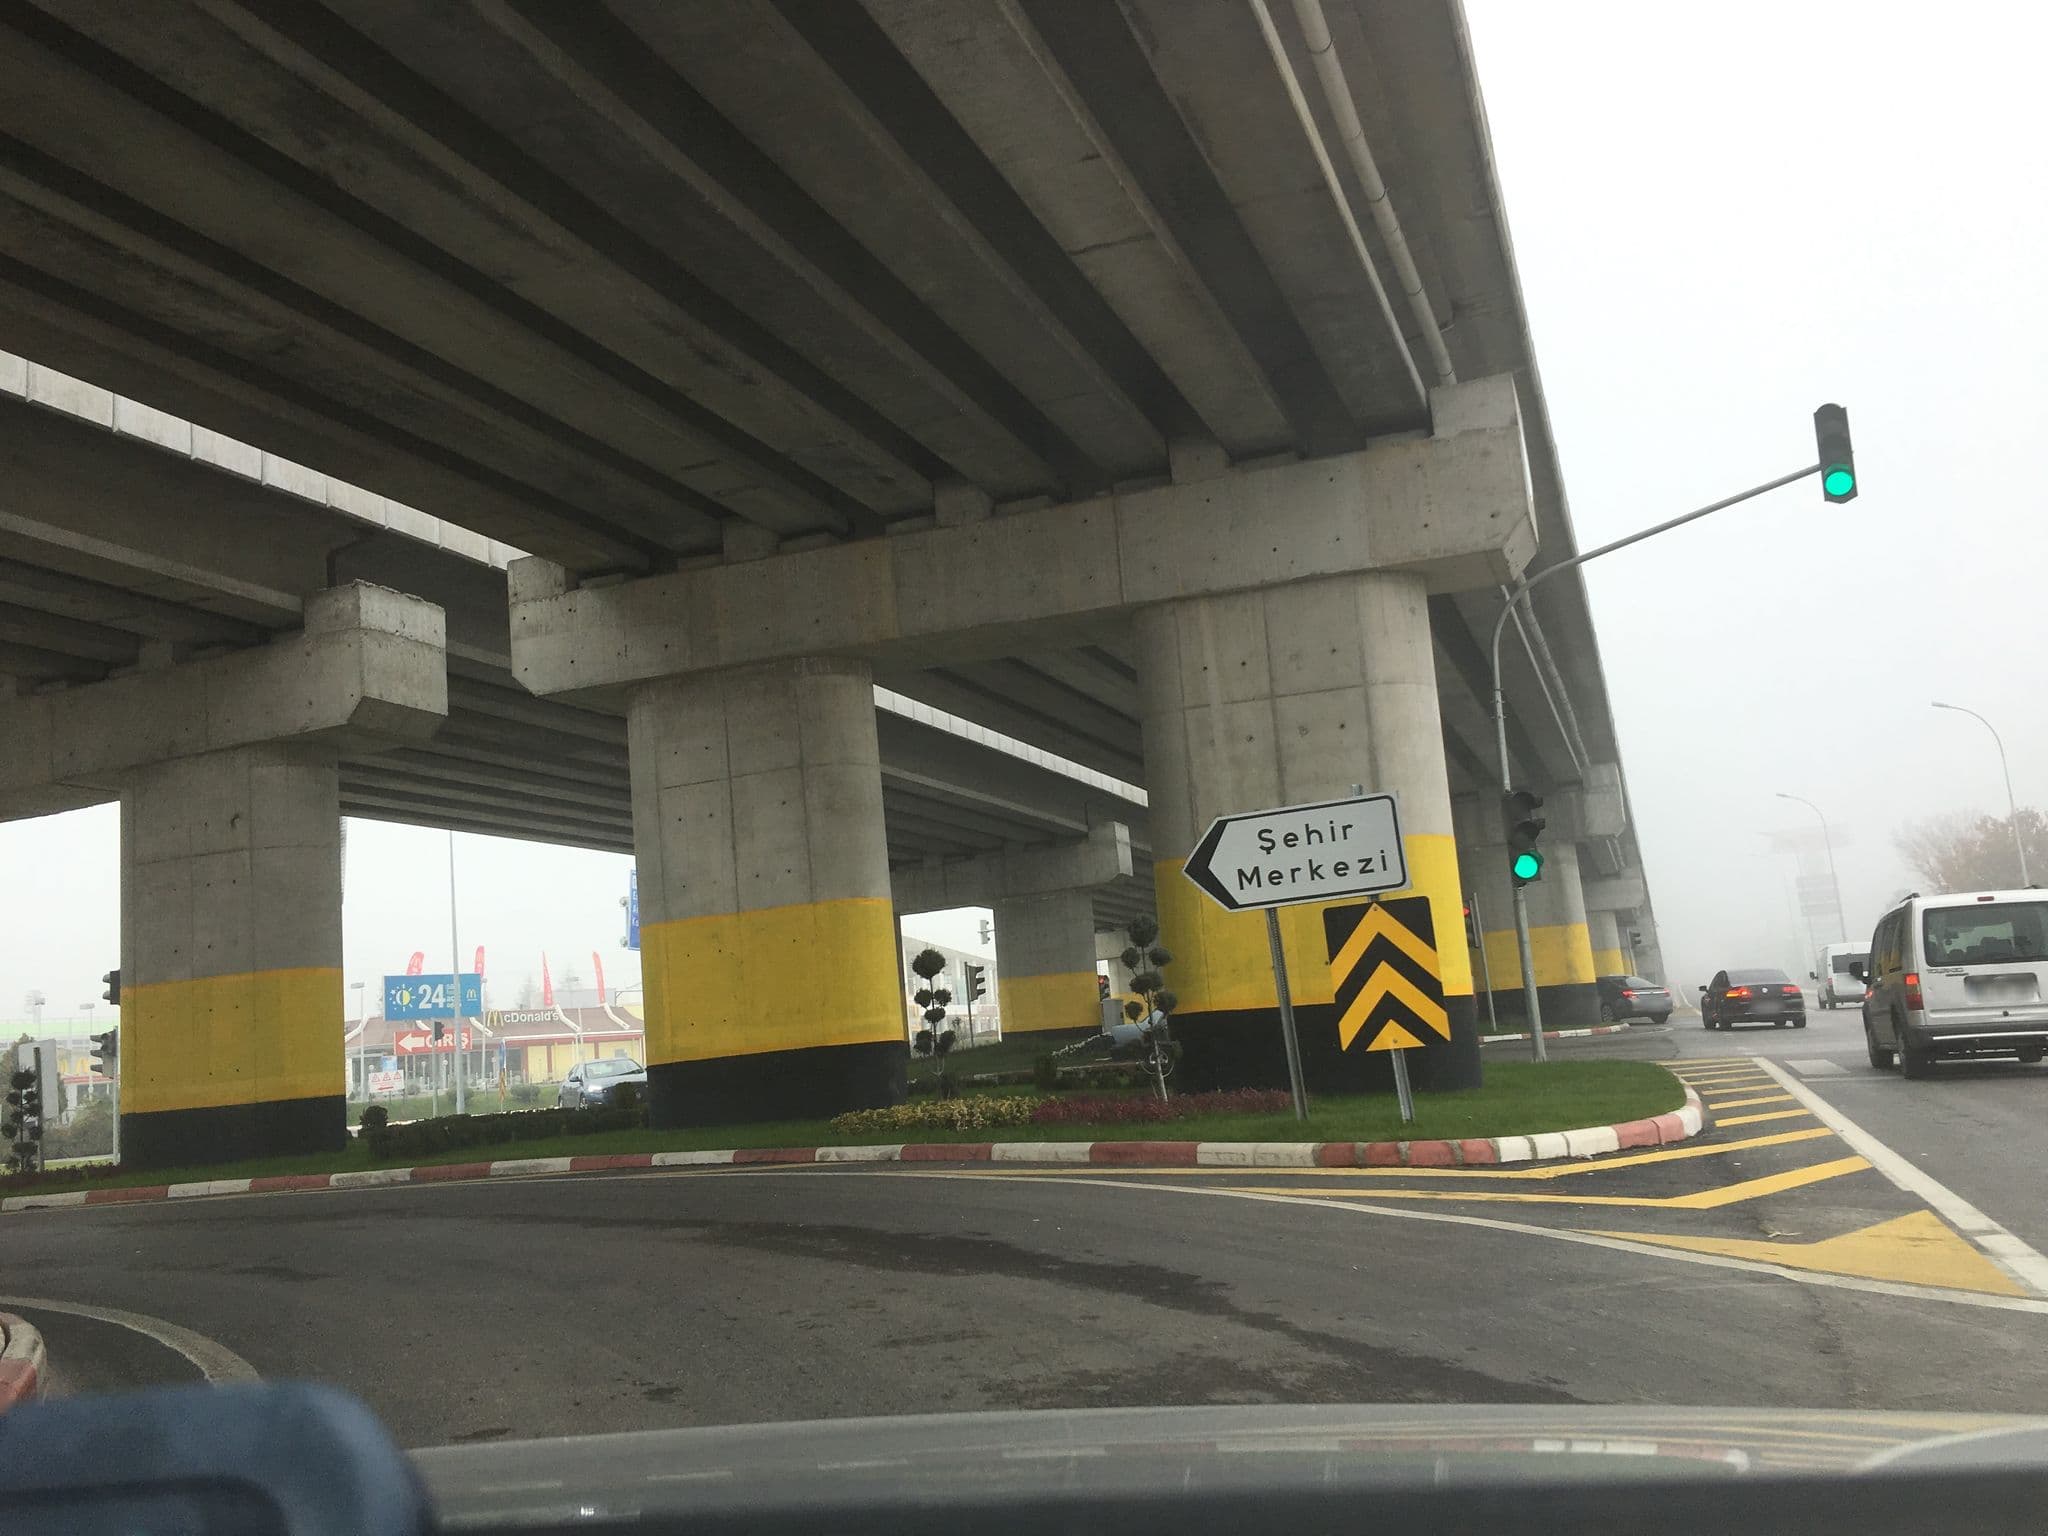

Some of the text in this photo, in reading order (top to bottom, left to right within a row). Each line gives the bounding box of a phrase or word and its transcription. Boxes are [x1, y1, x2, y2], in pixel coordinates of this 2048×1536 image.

[1256, 820, 1354, 855] Şehir
[1236, 849, 1388, 891] Merkezi
[418, 983, 446, 1010] 24
